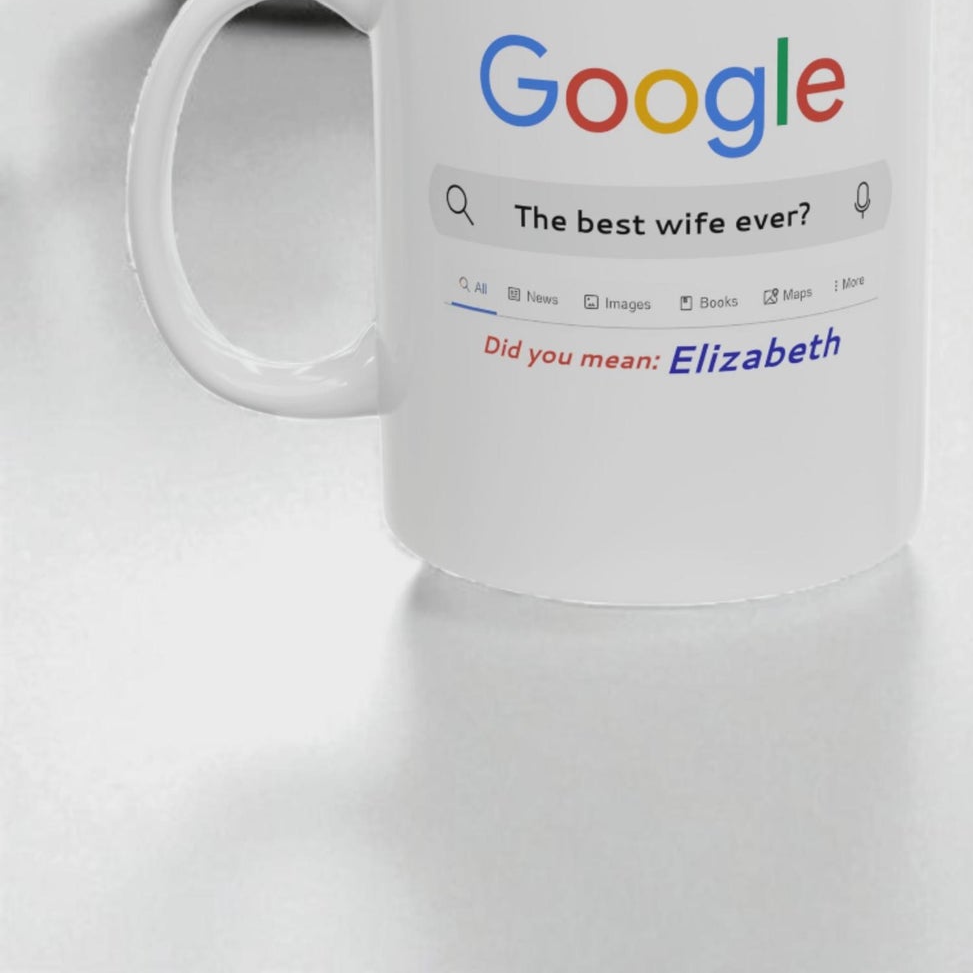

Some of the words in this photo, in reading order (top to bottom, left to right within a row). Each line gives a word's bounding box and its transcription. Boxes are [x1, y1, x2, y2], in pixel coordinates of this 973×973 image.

[479, 34, 846, 159] Google
[514, 204, 567, 232] The
[577, 209, 646, 236] best
[655, 212, 725, 236] wife
[735, 202, 811, 233] ever?
[474, 282, 487, 296] All
[527, 290, 558, 306] News
[605, 297, 651, 313] Images
[700, 296, 738, 309] Books
[783, 288, 813, 303] Maps
[842, 275, 865, 290] More
[484, 335, 522, 359] Did
[528, 347, 573, 368] you
[580, 352, 660, 370] mean:
[668, 325, 841, 375] Elizabeth
